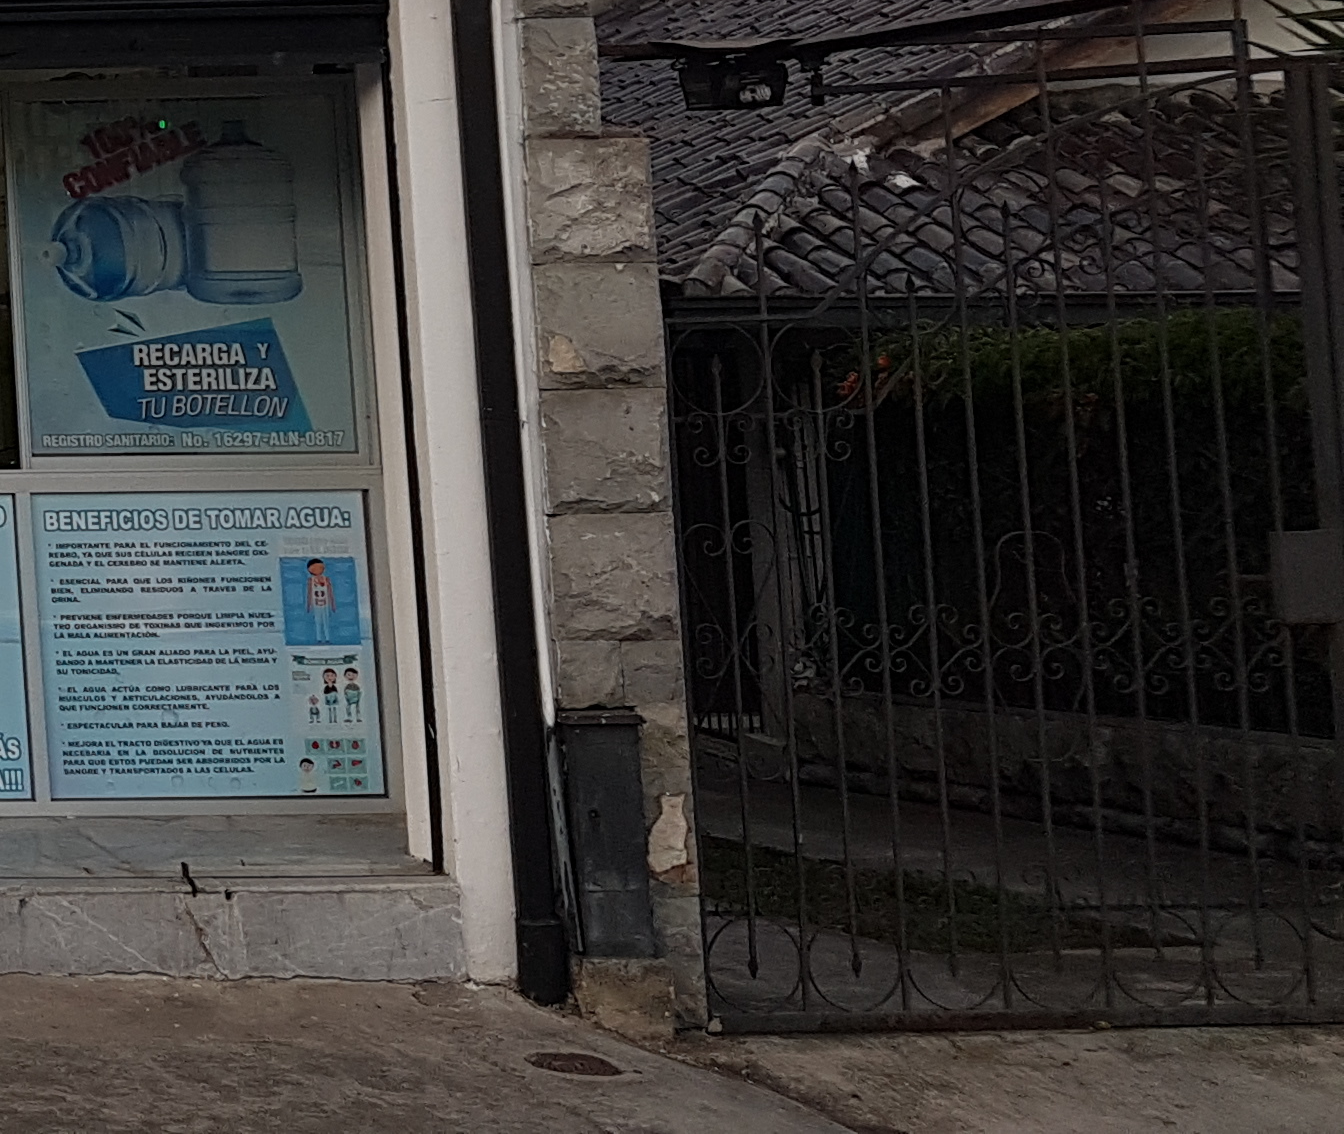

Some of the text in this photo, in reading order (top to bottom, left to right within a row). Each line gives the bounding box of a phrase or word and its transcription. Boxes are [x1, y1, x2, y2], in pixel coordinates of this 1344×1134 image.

[133, 342, 270, 366] RECARGA Y
[143, 367, 276, 392] ESTERILIZA
[137, 394, 289, 419] TU BOTELLON
[42, 430, 344, 448] REGISTRO SANITARIO: No. 16297-ALN-0817
[43, 507, 352, 532] BENEFICIOS DE TOMAR AGUA:
